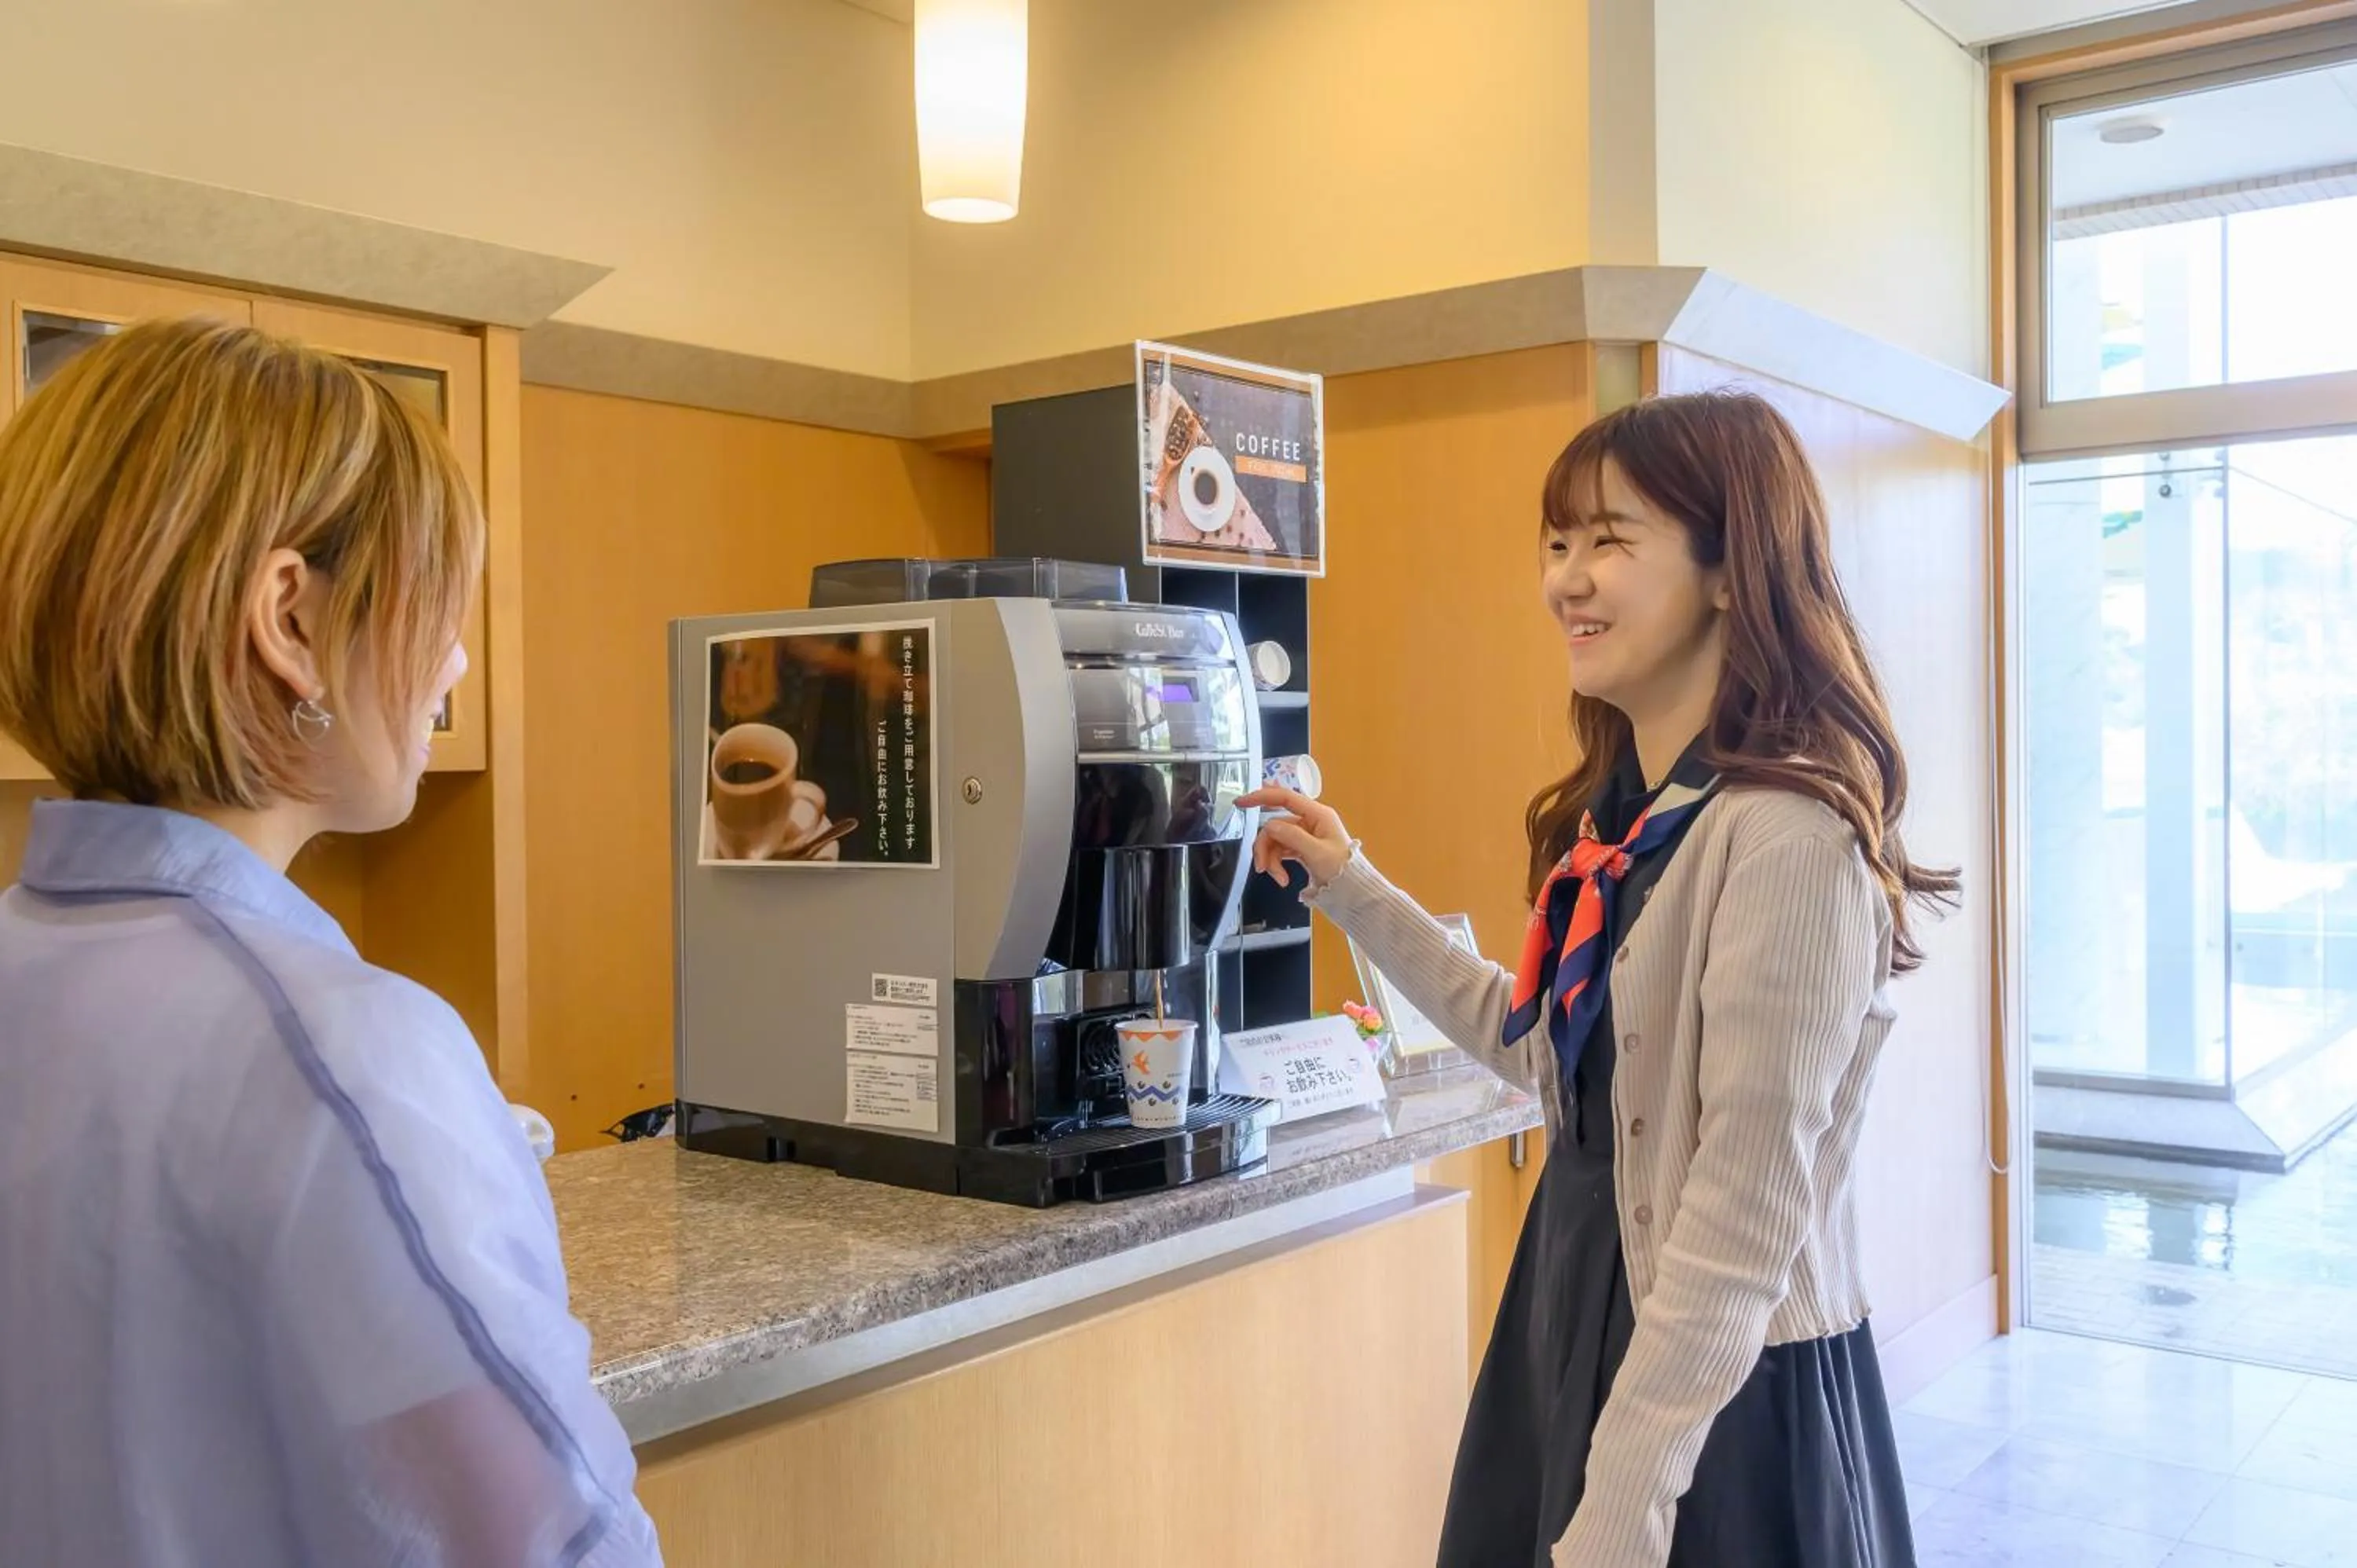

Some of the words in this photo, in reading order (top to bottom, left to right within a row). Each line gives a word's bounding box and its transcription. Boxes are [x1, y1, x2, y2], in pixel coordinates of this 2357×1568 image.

[1236, 432, 1301, 461] COFFEE
[877, 719, 889, 857] ご自由にお飲み下さい。
[1283, 1056, 1327, 1075] ご自由に
